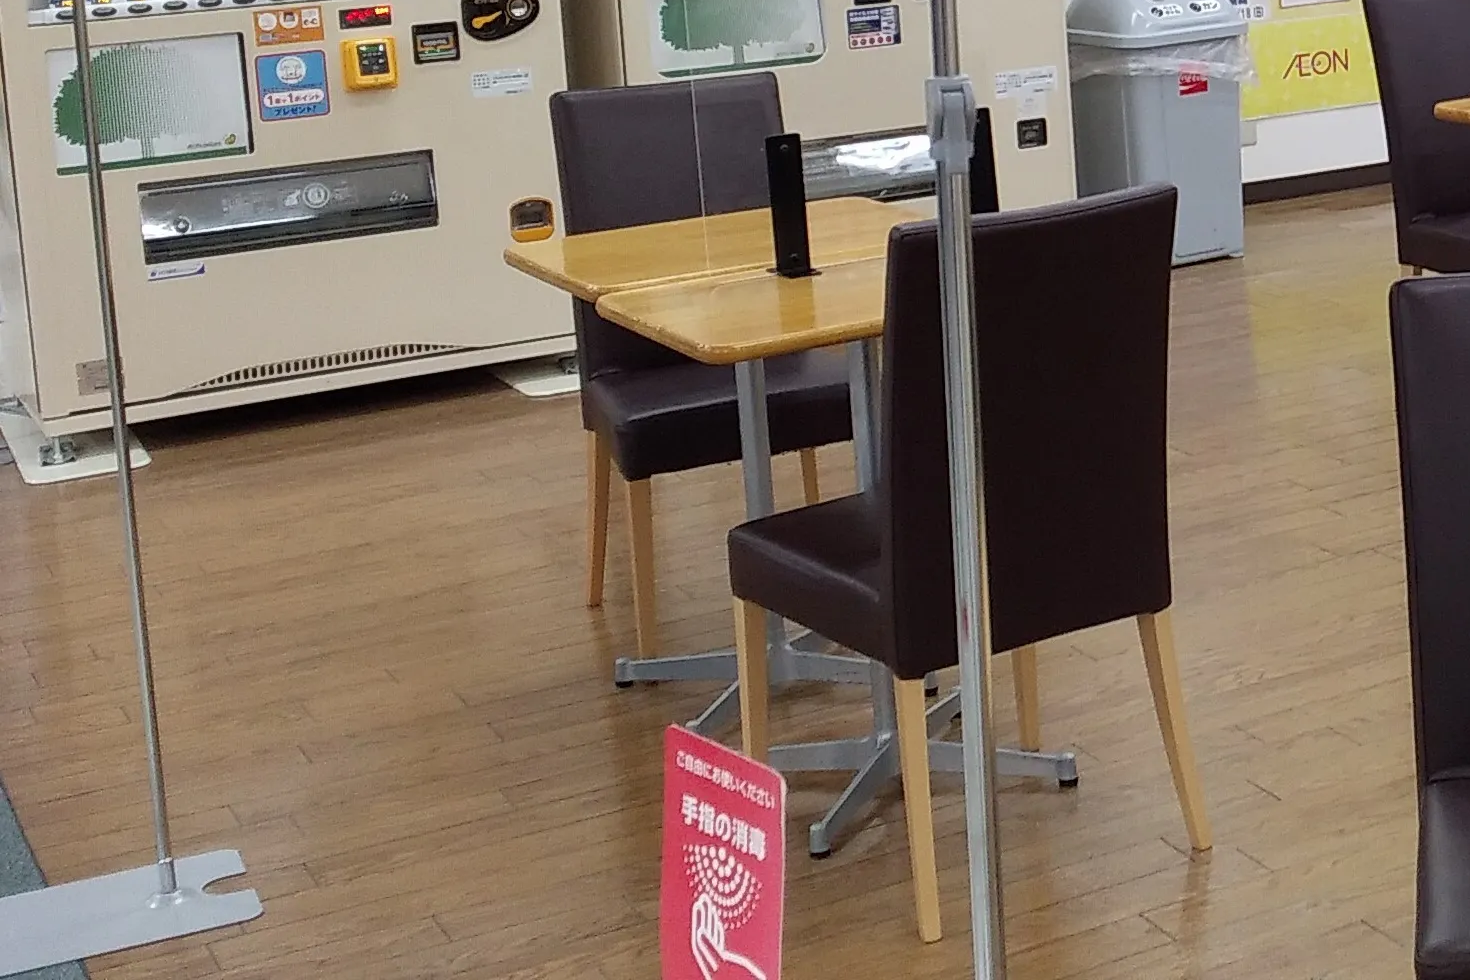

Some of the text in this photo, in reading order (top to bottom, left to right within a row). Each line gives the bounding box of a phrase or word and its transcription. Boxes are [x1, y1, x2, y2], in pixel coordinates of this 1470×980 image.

[676, 751, 776, 810] ご自由にお使いください
[681, 794, 767, 862] 手指の消毒
